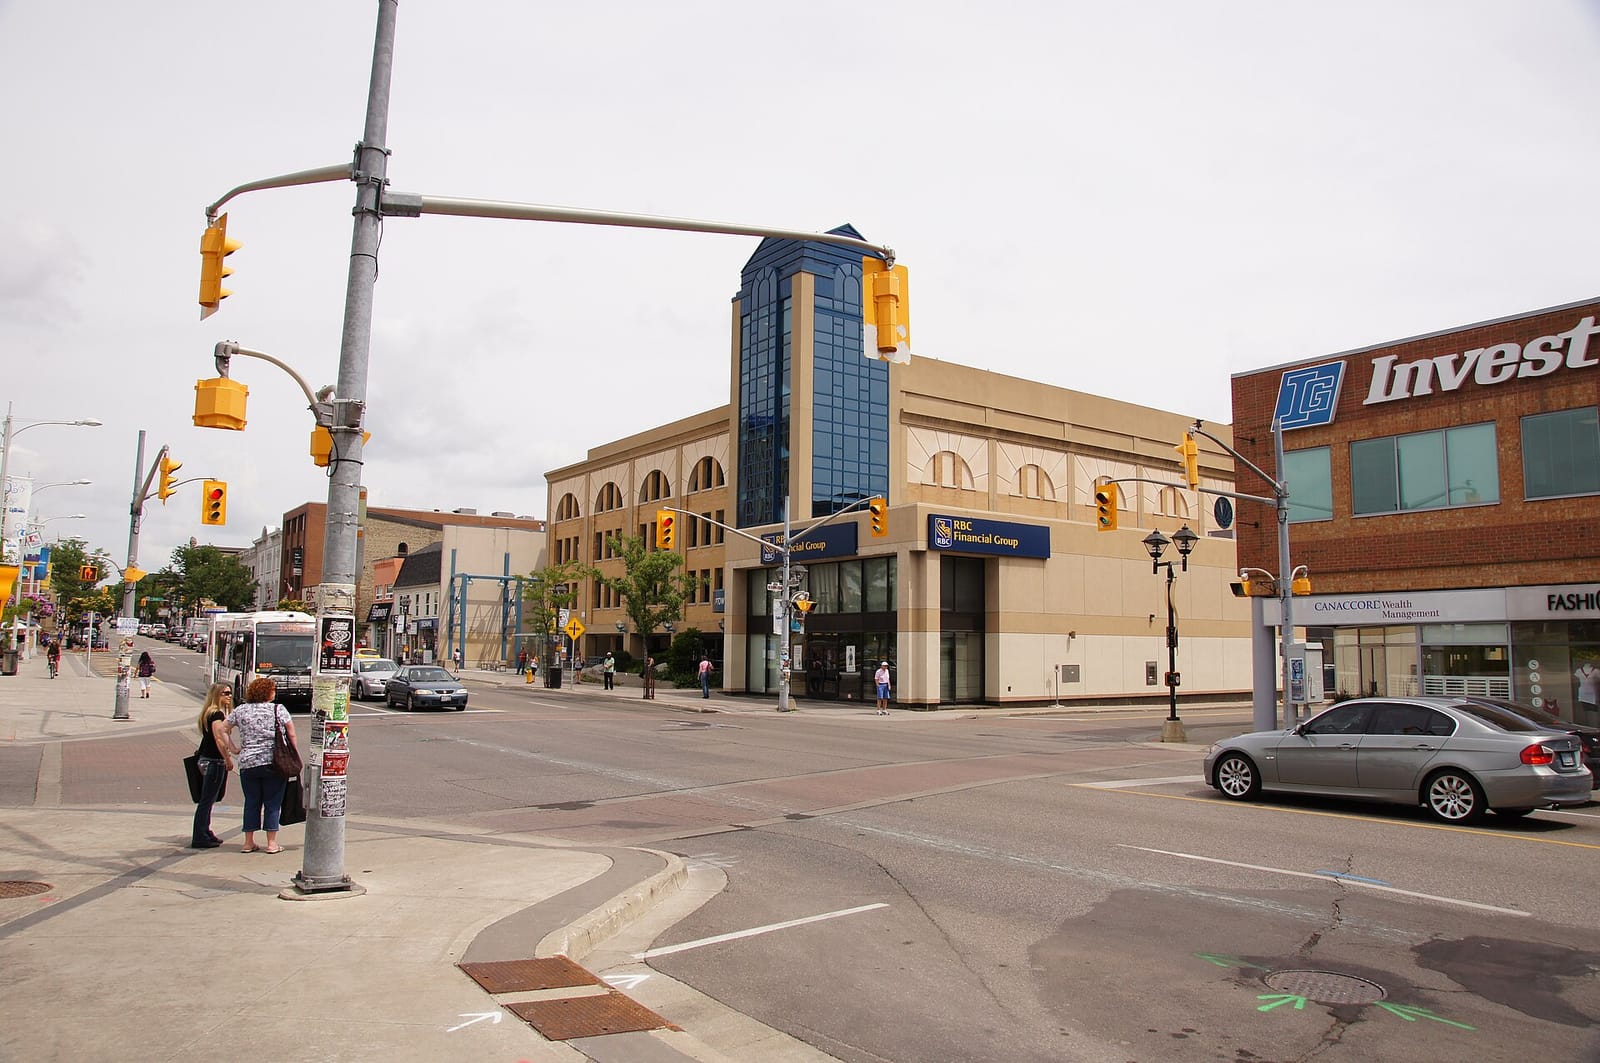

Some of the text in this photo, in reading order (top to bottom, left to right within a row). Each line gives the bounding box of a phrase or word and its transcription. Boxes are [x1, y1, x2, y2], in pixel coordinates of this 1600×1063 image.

[1363, 316, 1600, 406] Invest
[1280, 371, 1335, 425] IG
[953, 520, 973, 531] RBC
[775, 535, 785, 544] RB
[937, 537, 950, 545] RBC
[953, 531, 1019, 548] Financial Group
[805, 541, 826, 551] Group
[1314, 600, 1412, 611] CANACCORD Wealth
[1382, 609, 1440, 620] Management
[1529, 660, 1542, 706] SALE
